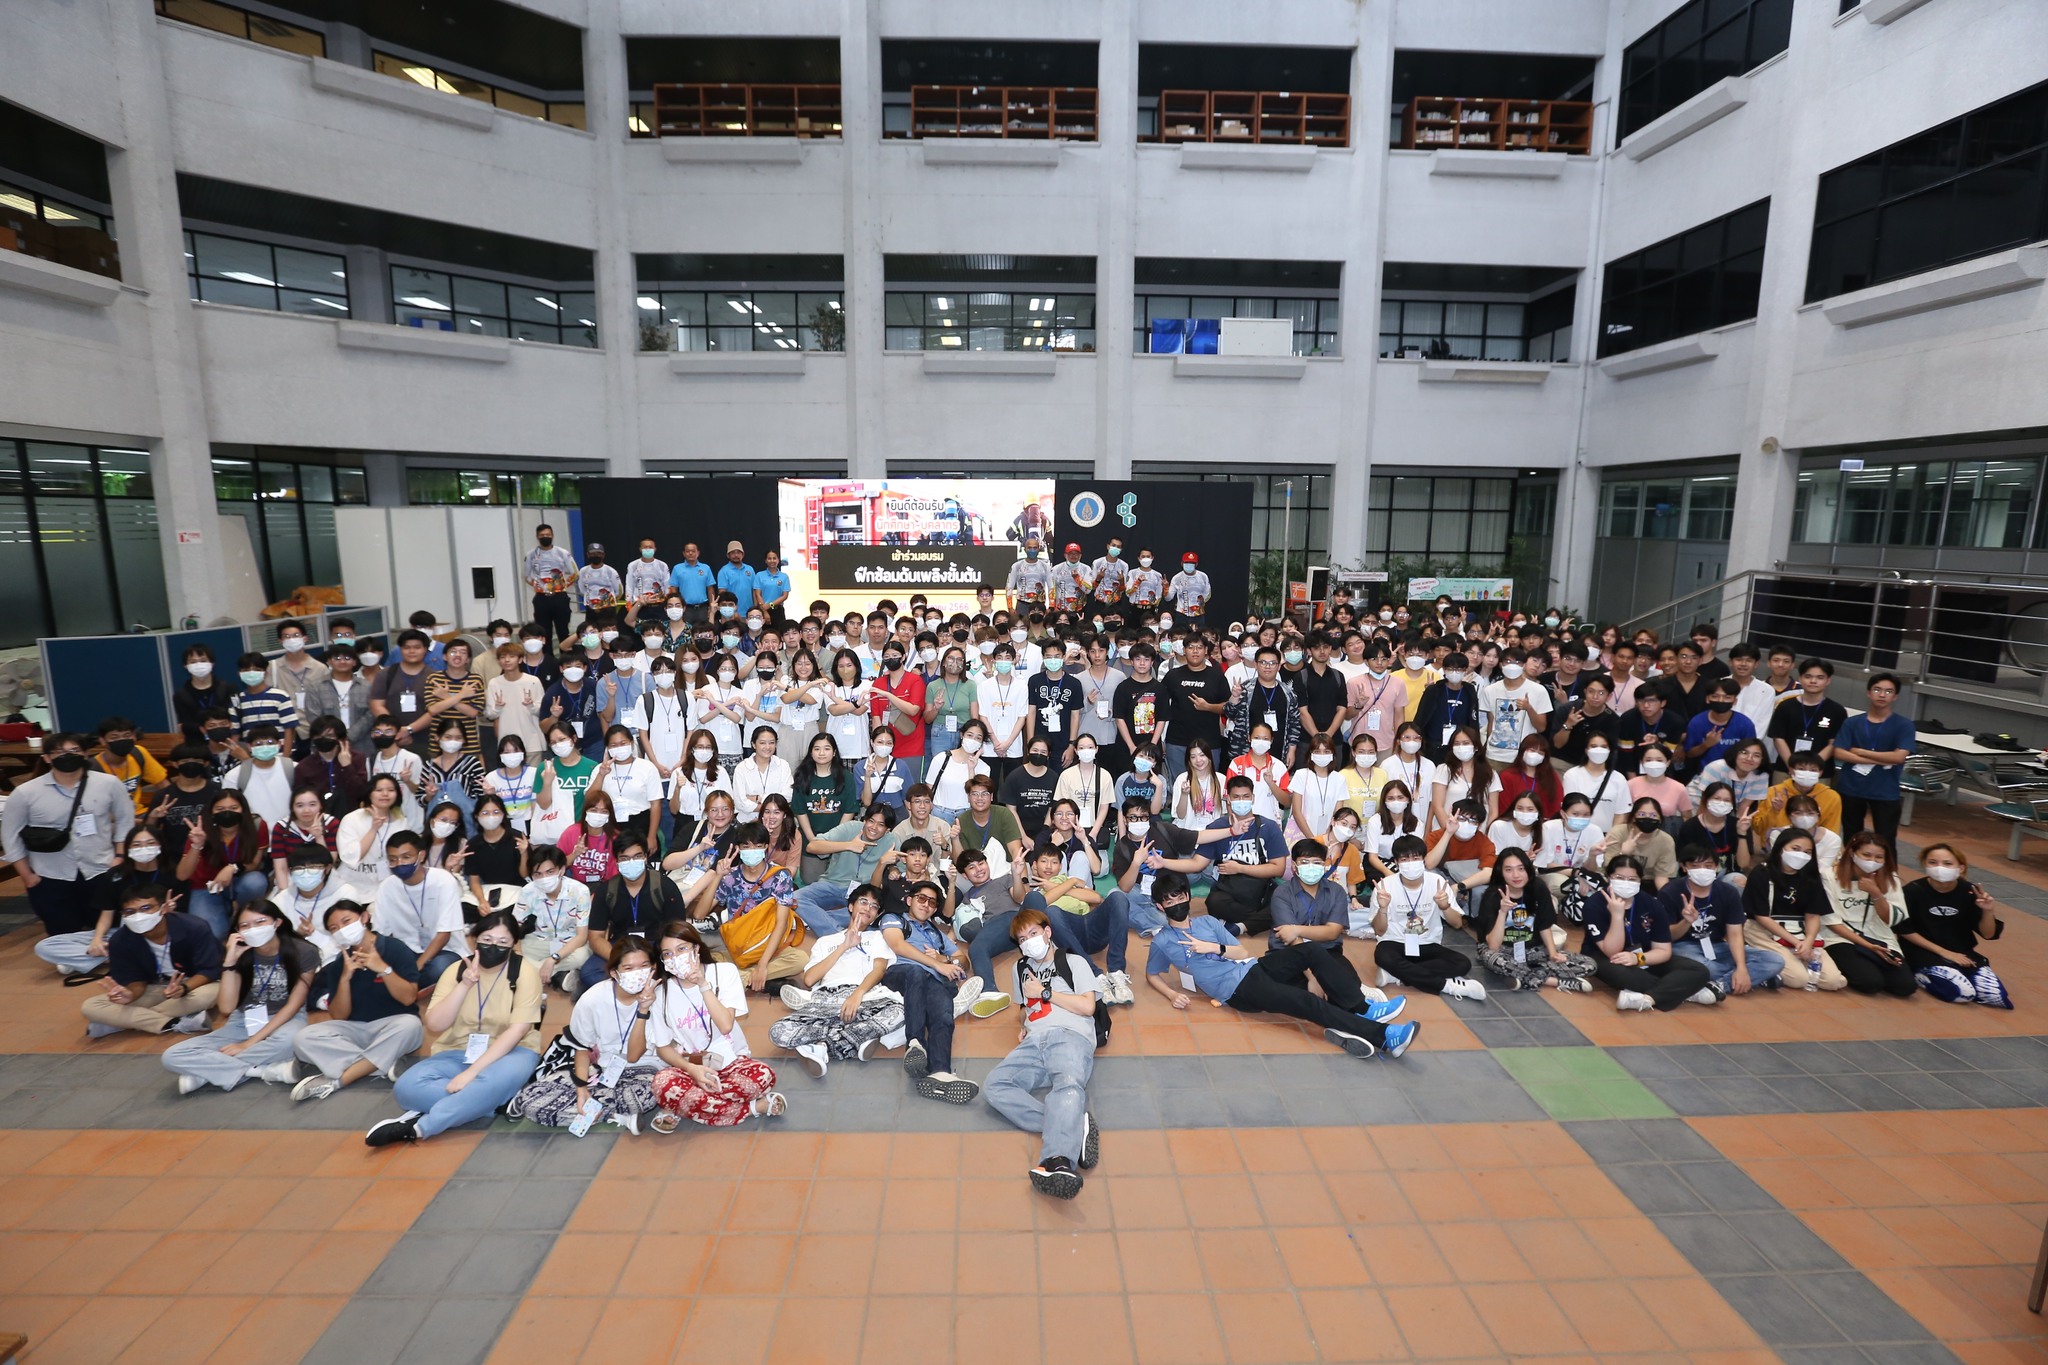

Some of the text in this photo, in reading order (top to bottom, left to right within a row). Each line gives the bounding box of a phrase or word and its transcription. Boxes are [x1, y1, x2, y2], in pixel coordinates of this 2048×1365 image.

[890, 499, 944, 512] ยินดีต้อนรับ
[891, 549, 944, 562] เข้าร่วมอบรม
[854, 562, 982, 584] ฝึกซ้อมดับเพลิงขั้นต้น
[949, 602, 970, 611] 2566
[573, 857, 606, 872] Pearls
[1588, 924, 1600, 936] 3
